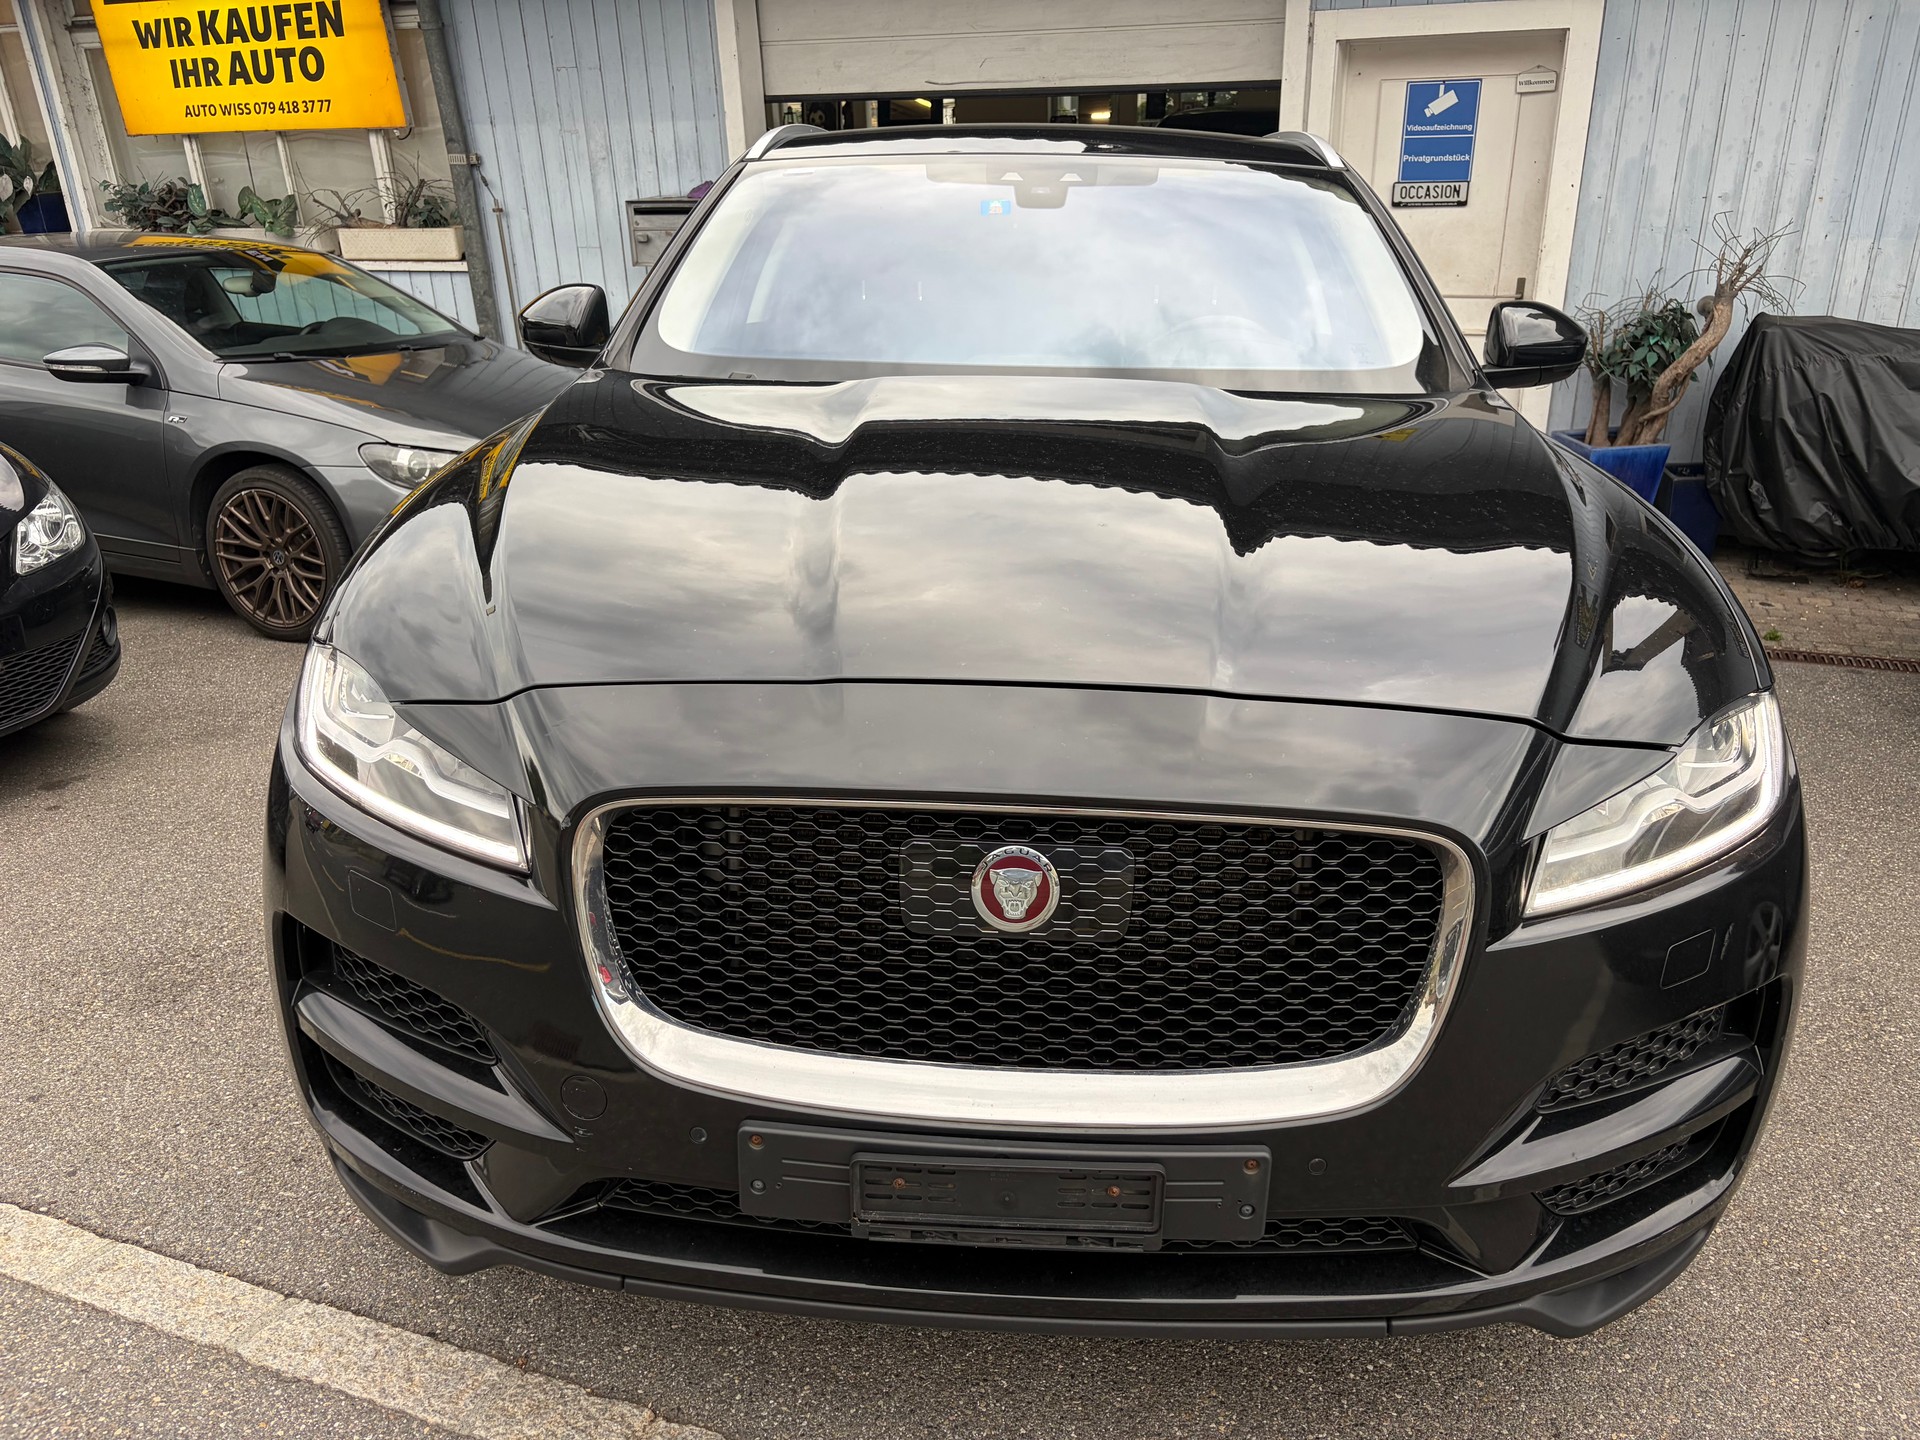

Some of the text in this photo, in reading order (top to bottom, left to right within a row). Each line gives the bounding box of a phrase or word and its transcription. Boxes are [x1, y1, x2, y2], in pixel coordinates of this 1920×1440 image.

[131, 0, 345, 50] WIR KAUFEN
[169, 45, 325, 89] IHR AUTO
[184, 99, 332, 118] AUTO WISS 079 418 37 77
[1406, 123, 1473, 132] Videoaufzeichnung
[1403, 153, 1471, 164] Privatgrundstück
[1400, 184, 1462, 200] OCCASION
[981, 846, 1053, 873] JAGUAR
